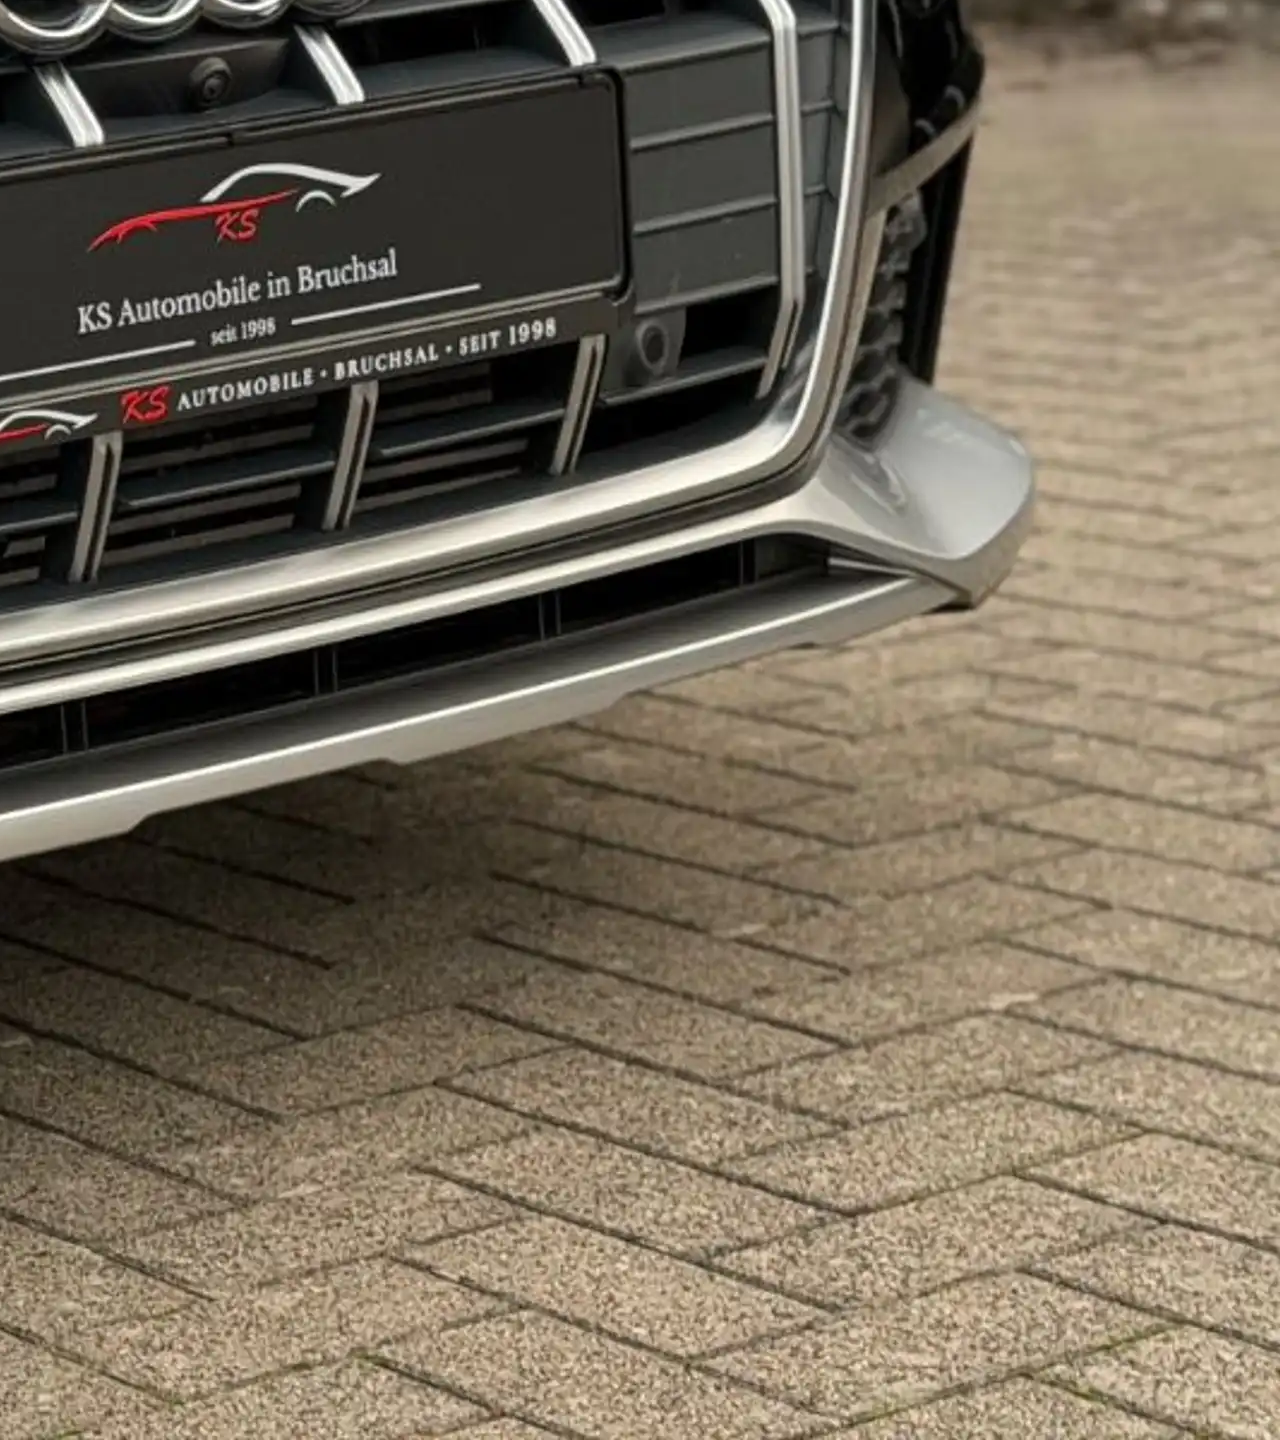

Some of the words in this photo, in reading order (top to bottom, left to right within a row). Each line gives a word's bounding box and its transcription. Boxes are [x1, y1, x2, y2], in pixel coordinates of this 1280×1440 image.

[214, 208, 260, 246] KS
[77, 302, 113, 334] KS
[117, 275, 261, 326] Automobile
[266, 271, 291, 299] in
[297, 247, 397, 294] Bruchsal
[210, 323, 238, 346] seit
[240, 316, 276, 341] 1998
[119, 383, 172, 425] KS
[178, 367, 314, 411] AUTOMOBILE
[334, 344, 439, 380] BRUCHSAL
[459, 330, 502, 356] SEIT
[509, 317, 557, 346] 1998
